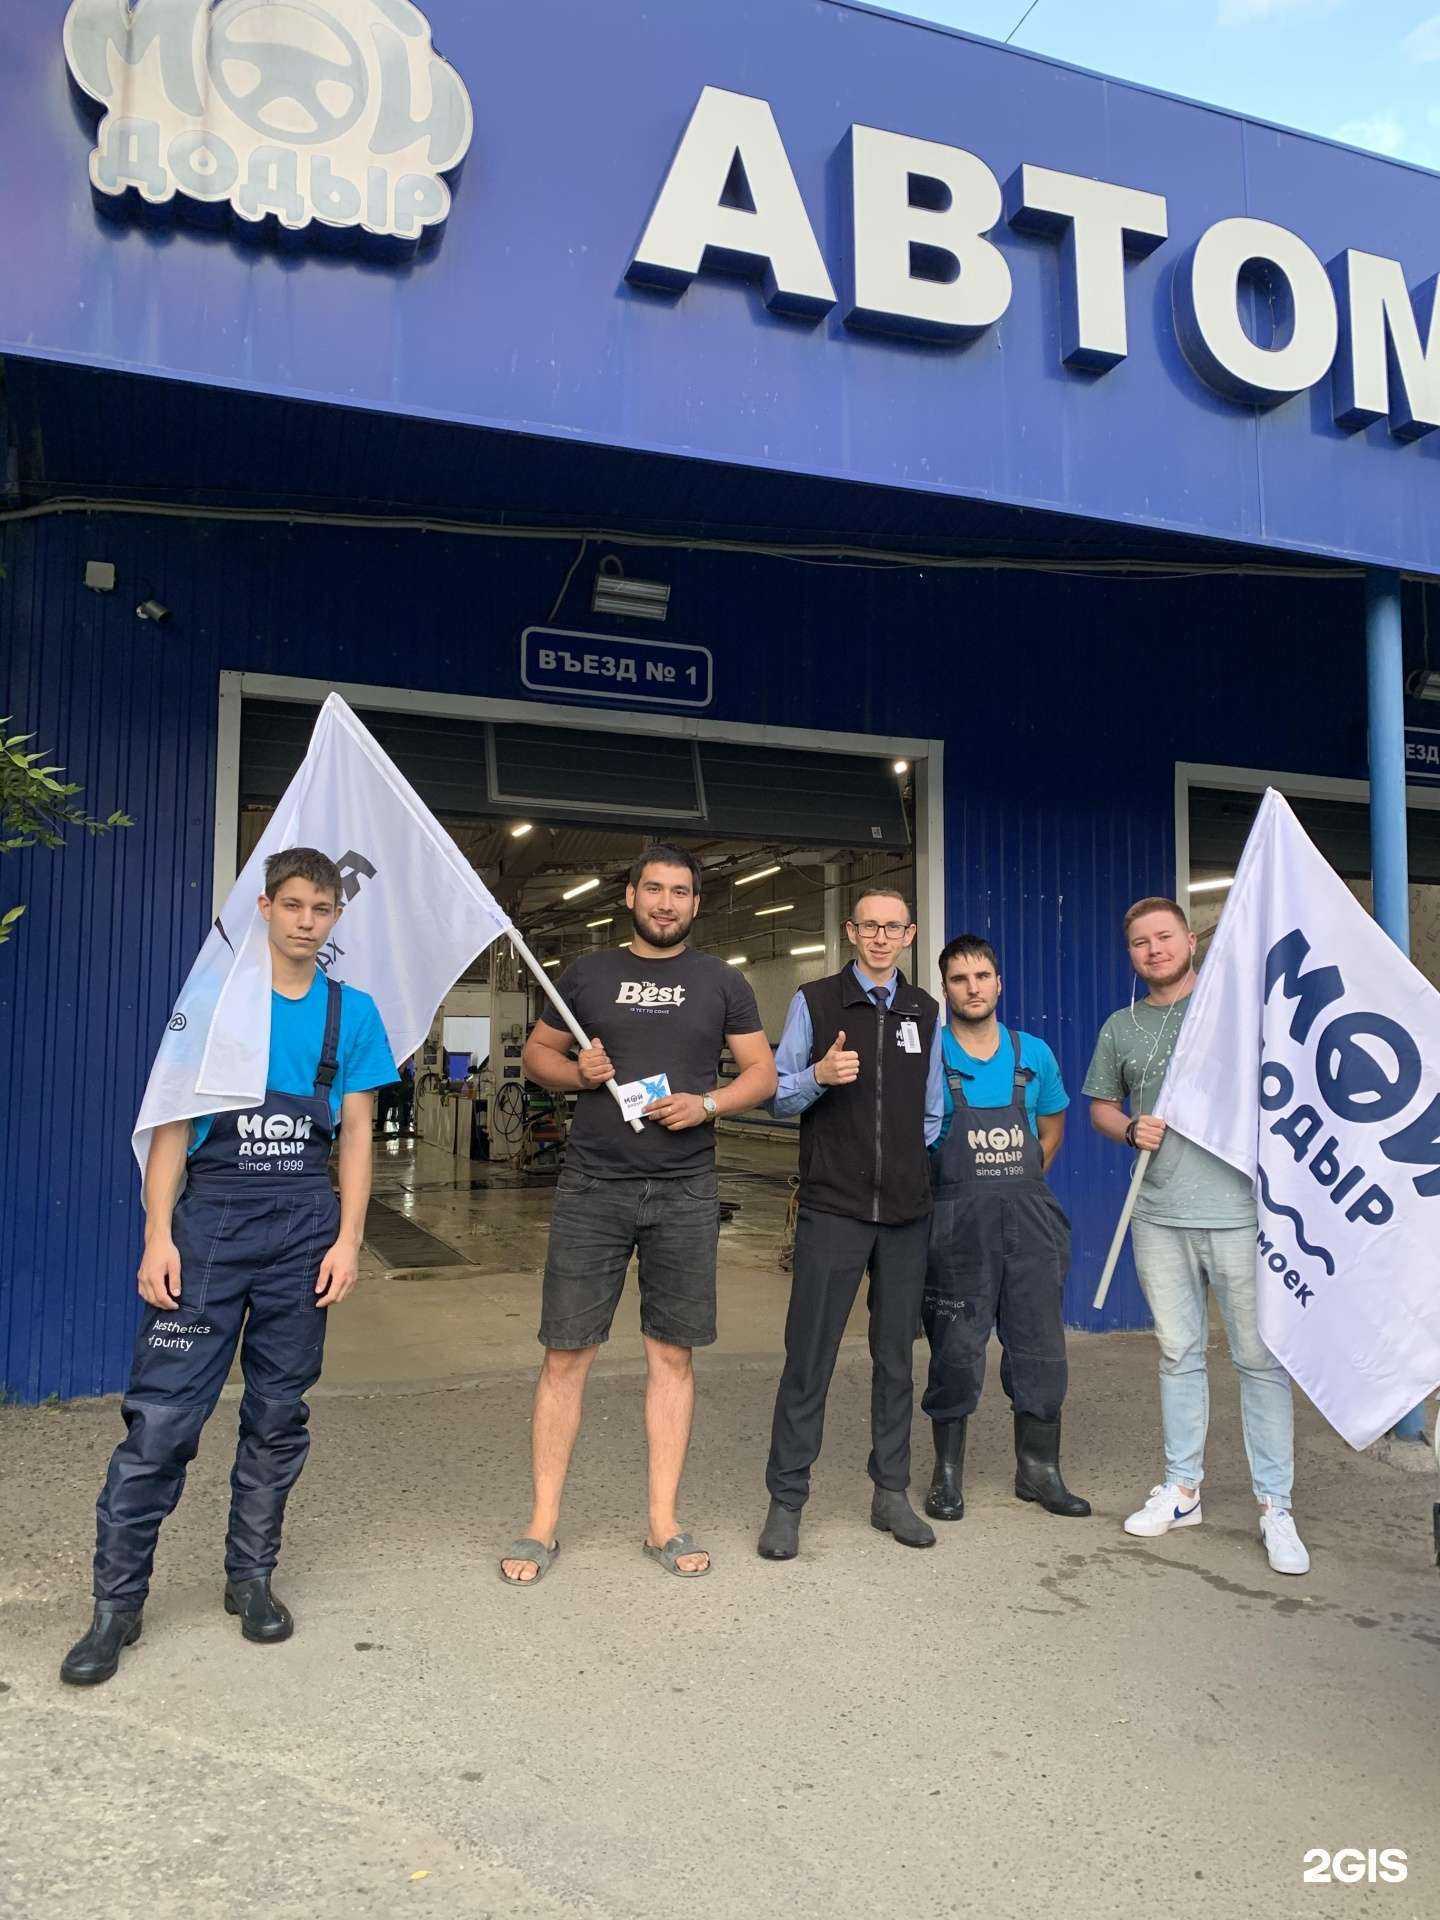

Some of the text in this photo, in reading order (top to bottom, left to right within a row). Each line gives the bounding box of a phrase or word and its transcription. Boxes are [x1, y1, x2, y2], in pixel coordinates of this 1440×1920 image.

[97, 117, 442, 232] ДОДЫР
[538, 649, 697, 686] ВЪЕЗД № 1
[1405, 743, 1440, 765] ЕЗД
[615, 982, 686, 1007] Best
[237, 1113, 313, 1140] МОЙ
[967, 1124, 1025, 1151] МОЙ
[238, 1141, 305, 1157] ДОДЫР
[1260, 1060, 1395, 1226] ОДЫР
[238, 1160, 304, 1171] since 1999
[975, 1150, 1023, 1164] ДОДЫР
[975, 1165, 1025, 1176] since 1999
[1256, 1229, 1315, 1309] моек
[152, 1337, 194, 1352] purity
